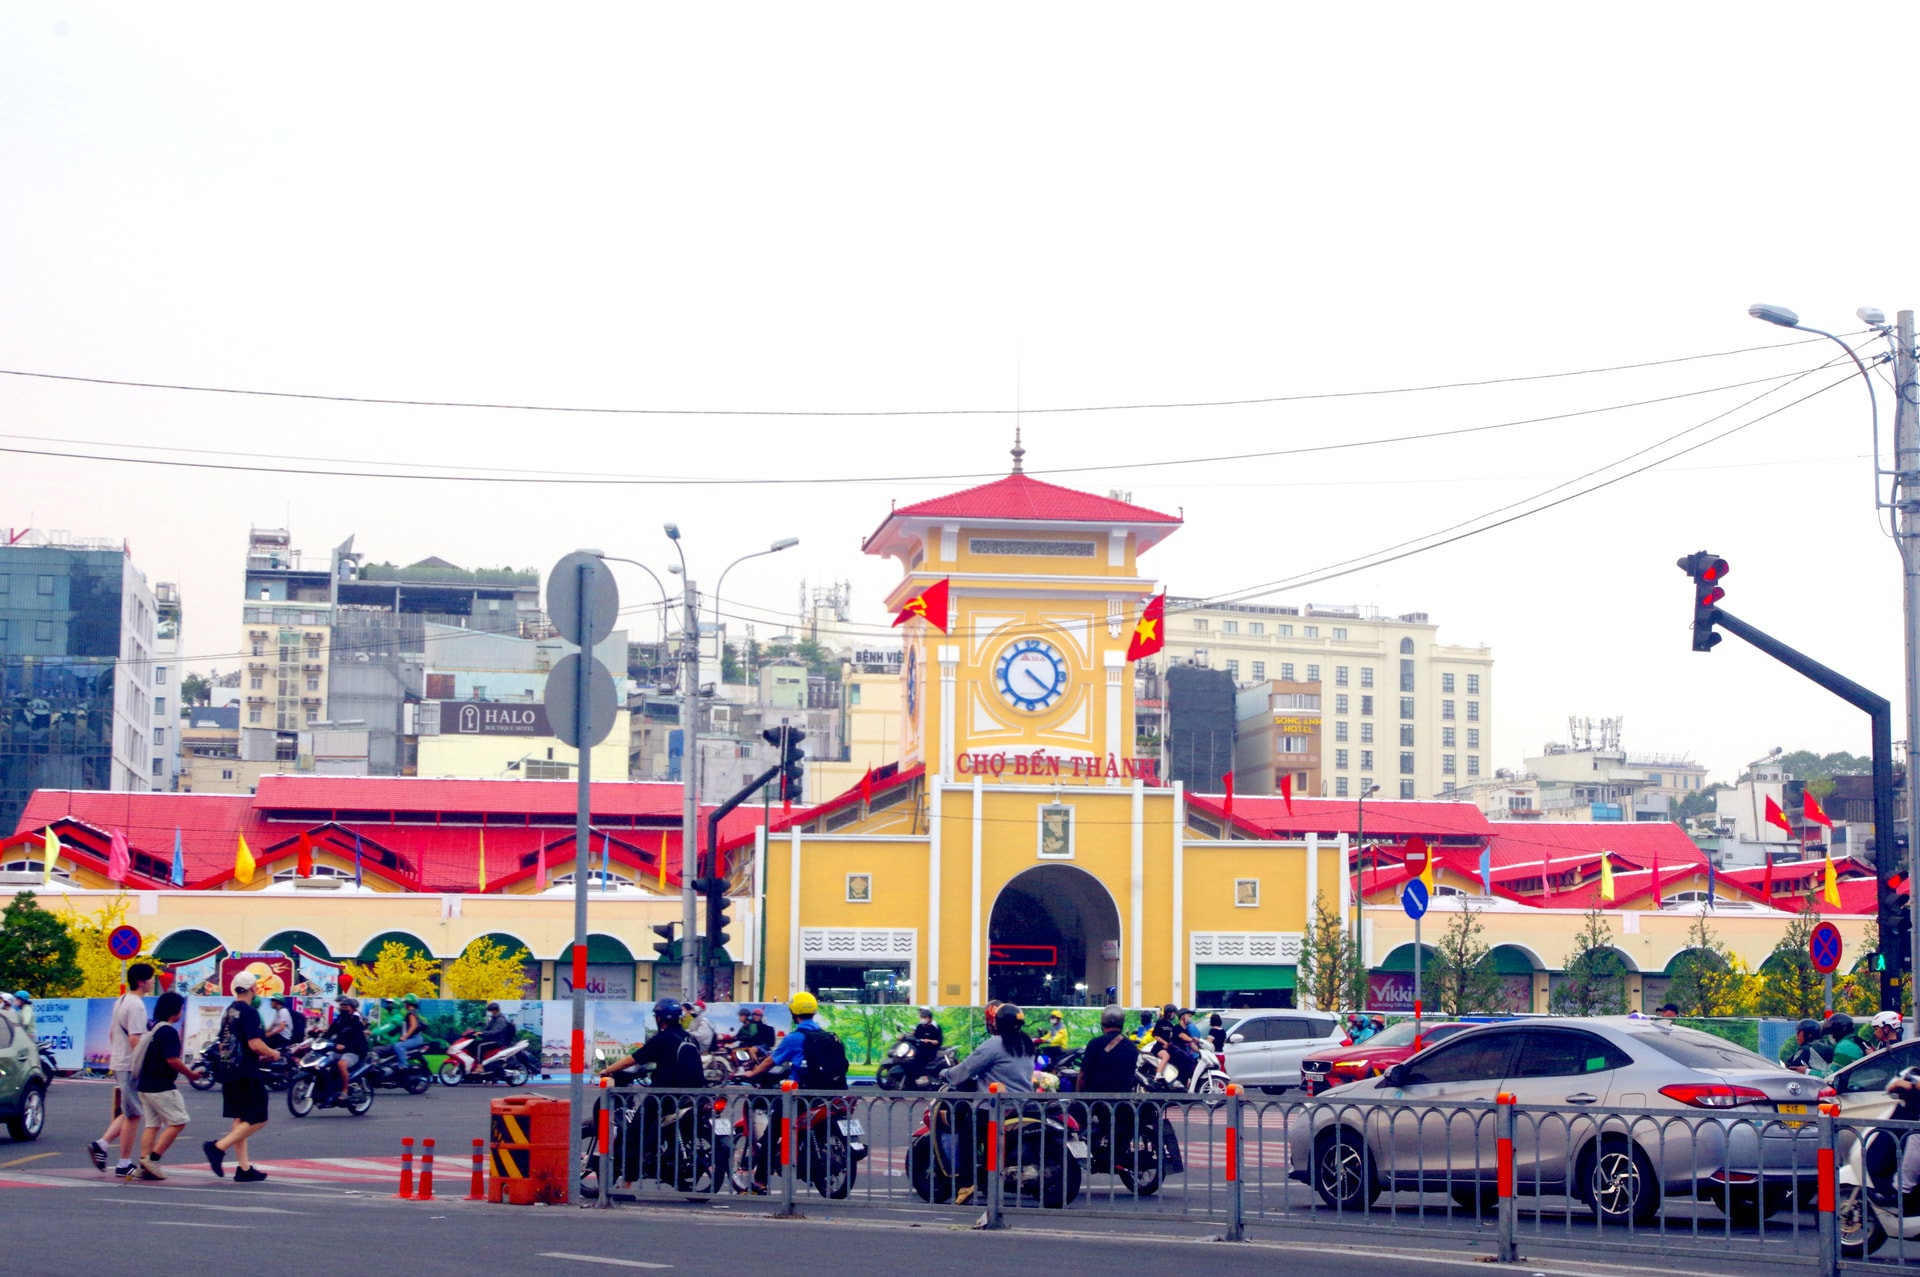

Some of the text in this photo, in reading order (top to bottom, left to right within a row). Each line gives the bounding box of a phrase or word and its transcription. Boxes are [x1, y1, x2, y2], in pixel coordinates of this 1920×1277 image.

[485, 709, 535, 724] HALO
[1283, 724, 1312, 734] HOTEL
[956, 748, 1155, 778] CHỢ BẾN THÀNH
[1371, 978, 1413, 1002] Vikki
